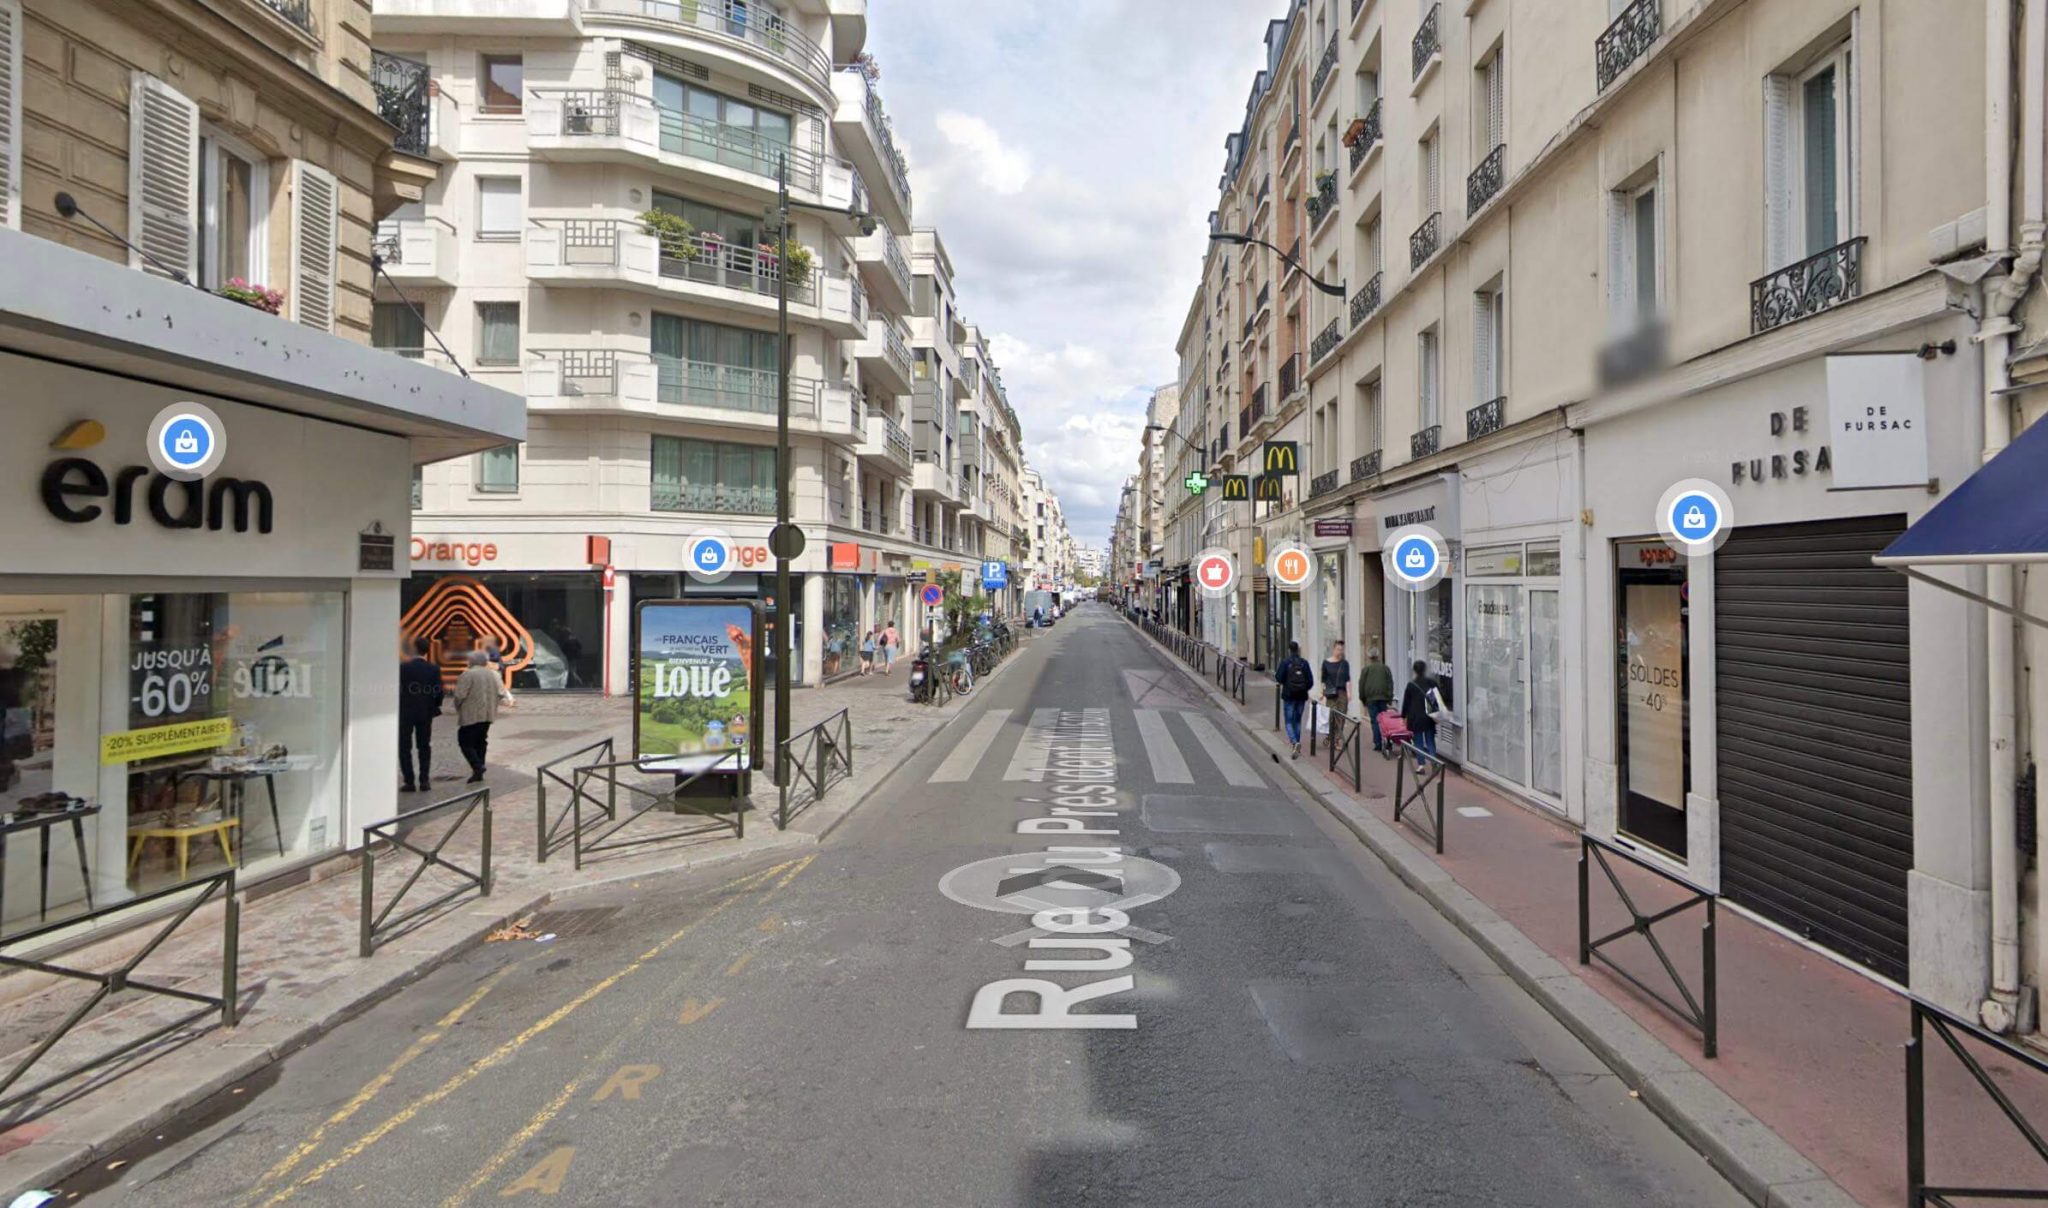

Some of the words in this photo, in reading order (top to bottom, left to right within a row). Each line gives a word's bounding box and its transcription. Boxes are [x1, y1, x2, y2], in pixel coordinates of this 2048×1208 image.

[1769, 406, 1810, 437] DE
[1866, 405, 1887, 417] DE
[1844, 419, 1912, 432] FURSAC
[1731, 446, 1831, 485] FURSA
[411, 536, 498, 566] Orange
[663, 635, 719, 645] FRANÇAIS
[701, 645, 729, 655] VERT
[131, 643, 212, 671] JUSQU'À
[653, 660, 732, 699] Loué
[1629, 662, 1679, 688] SOLDES
[131, 671, 210, 718] -60%
[106, 735, 134, 750] -20%
[135, 721, 227, 746] SUPPLÉMENTAIRES
